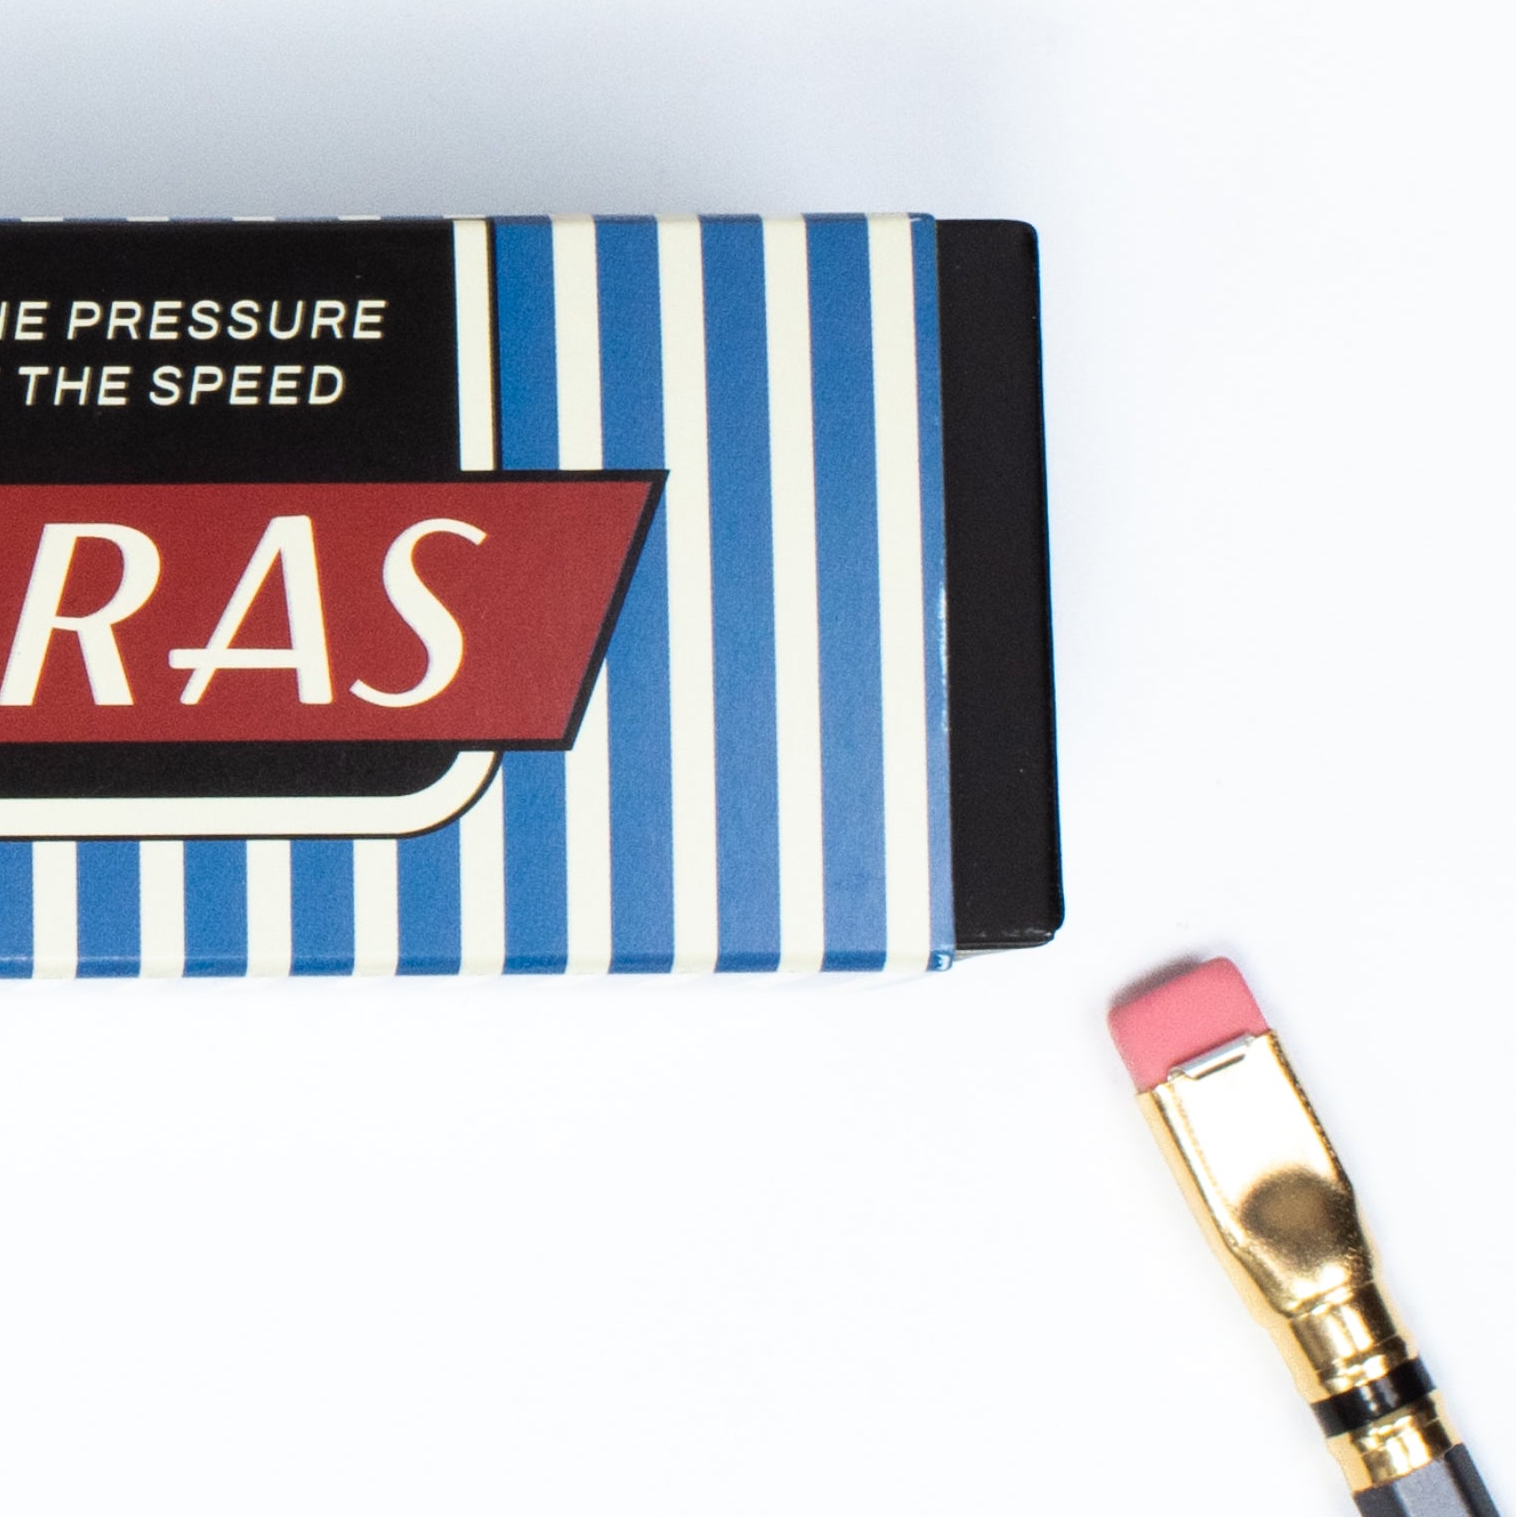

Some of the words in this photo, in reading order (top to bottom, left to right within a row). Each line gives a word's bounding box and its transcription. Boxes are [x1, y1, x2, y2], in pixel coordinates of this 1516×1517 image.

[66, 299, 388, 341] PRESSURE
[17, 366, 131, 407] THE
[149, 364, 346, 407] SPEED
